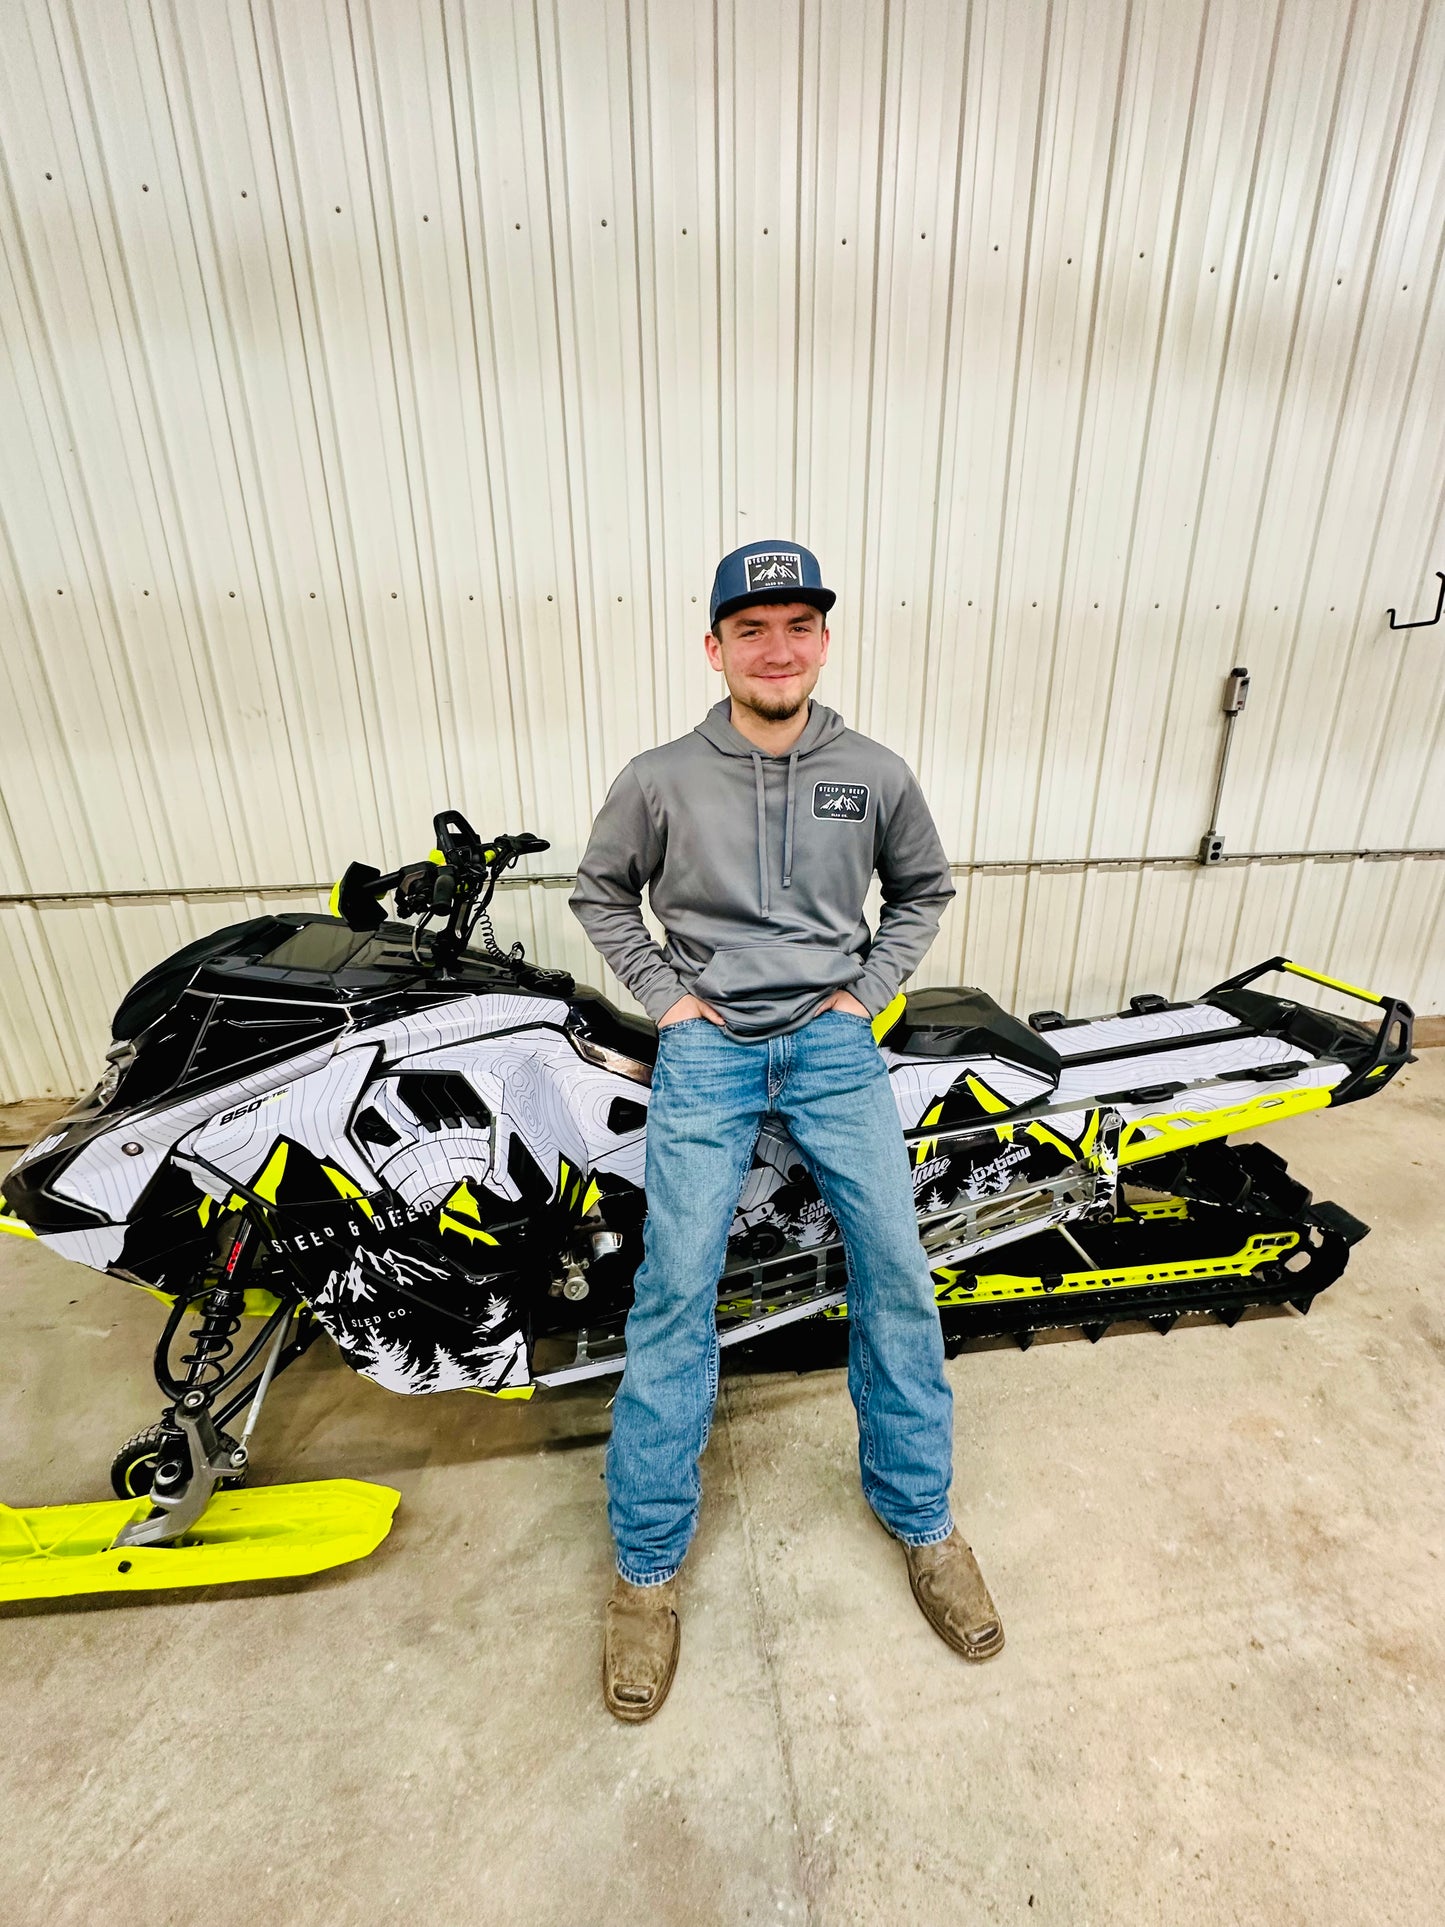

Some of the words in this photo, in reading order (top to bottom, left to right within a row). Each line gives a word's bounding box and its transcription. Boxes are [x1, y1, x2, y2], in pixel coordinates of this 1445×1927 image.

[219, 1099, 263, 1126] 850
[911, 1157, 952, 1187] tane
[348, 1220, 360, 1237] &
[372, 1200, 435, 1232] DEEP
[351, 1315, 382, 1328] SLED
[388, 1308, 413, 1320] CO.
